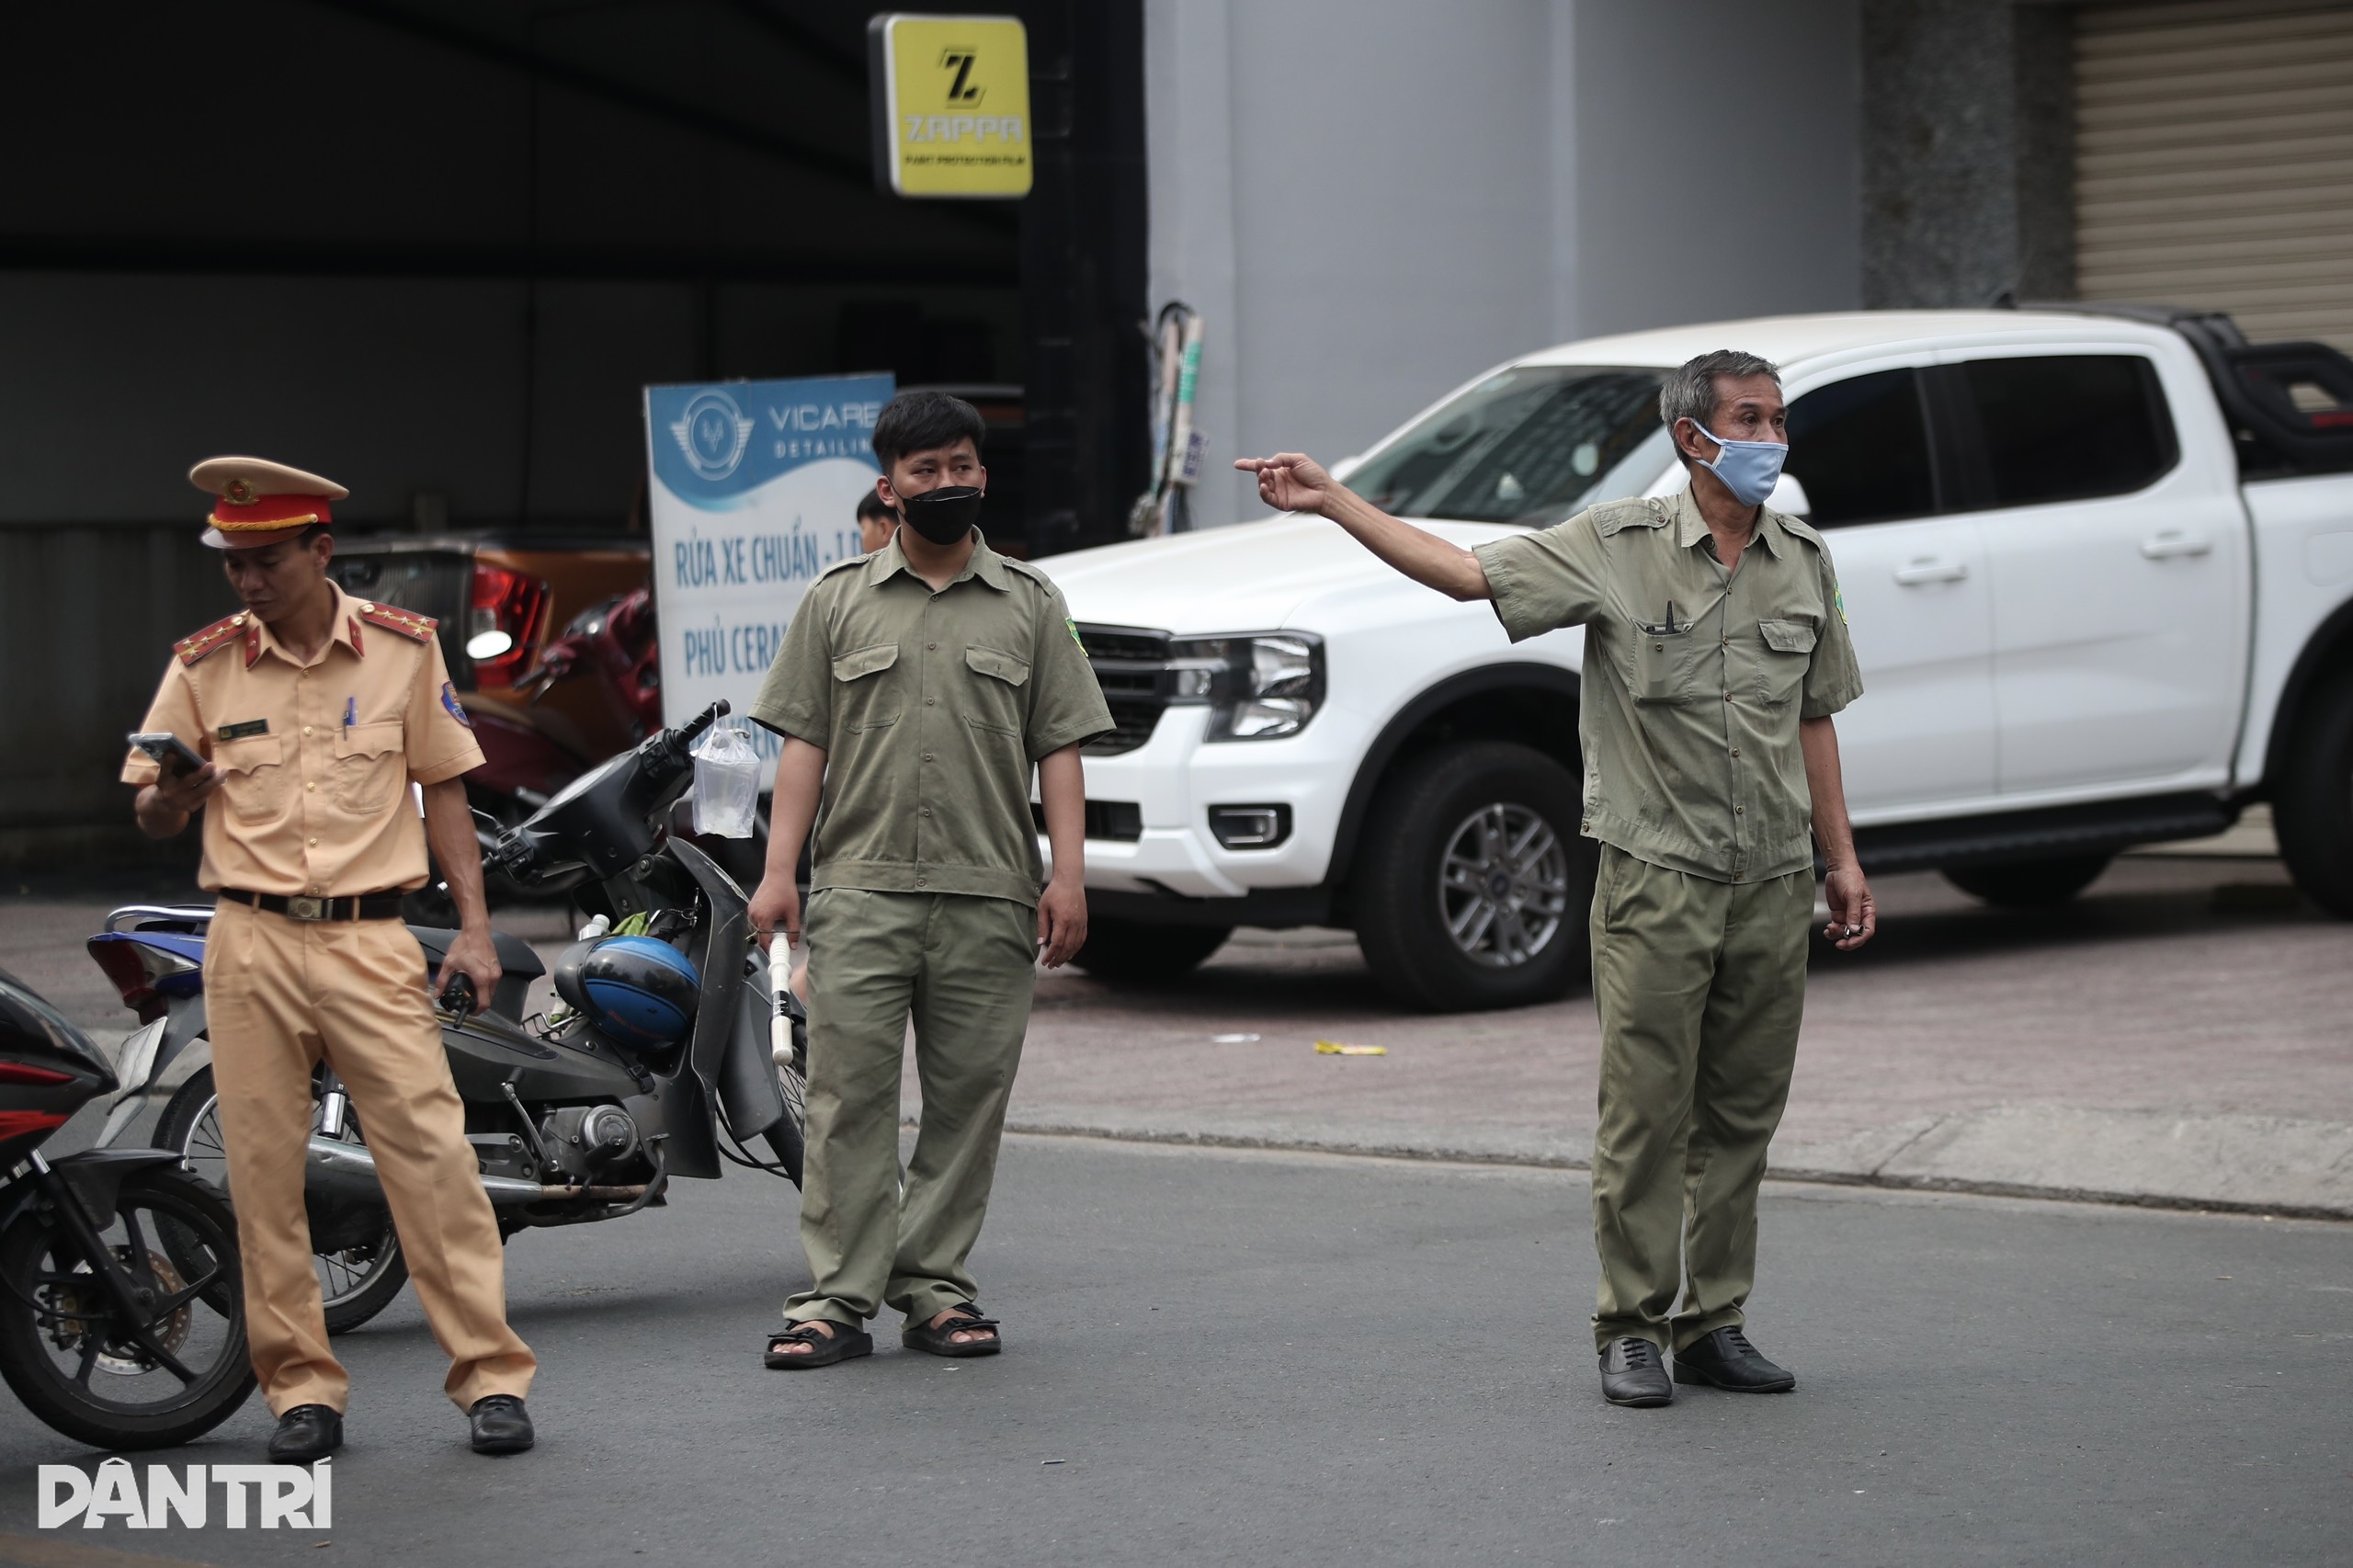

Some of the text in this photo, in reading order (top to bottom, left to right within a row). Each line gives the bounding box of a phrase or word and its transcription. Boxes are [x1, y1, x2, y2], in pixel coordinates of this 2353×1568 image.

[940, 50, 983, 108] Z
[904, 115, 1023, 143] ZAPPA
[768, 402, 882, 432] VICARE
[774, 437, 872, 460] DETAILIN
[676, 526, 718, 589] RỬA
[722, 537, 746, 585] XE
[684, 613, 788, 678] PHỦ CERA
